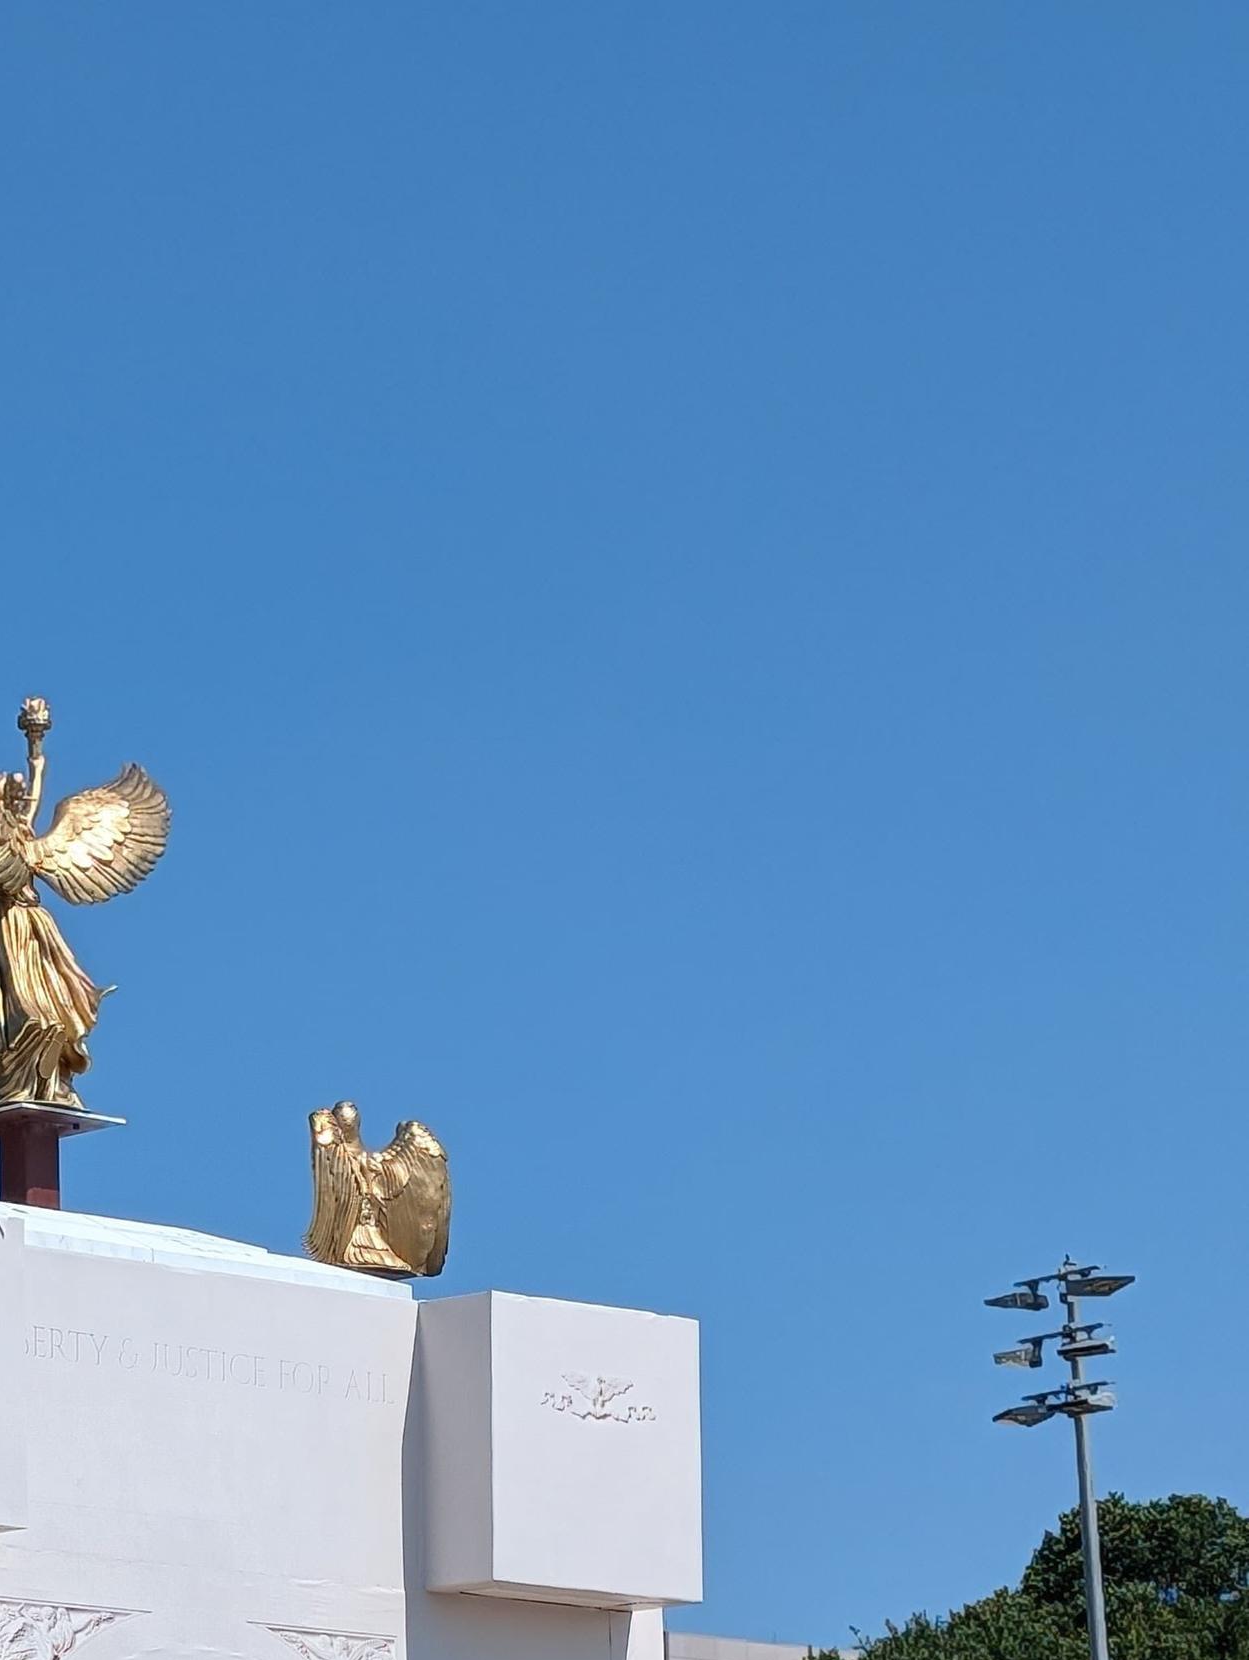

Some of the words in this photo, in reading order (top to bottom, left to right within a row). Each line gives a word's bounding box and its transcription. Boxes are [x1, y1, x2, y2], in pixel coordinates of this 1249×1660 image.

[117, 1336, 139, 1370] &
[152, 1341, 267, 1388] JUSTICE
[279, 1358, 331, 1395] FOR
[344, 1368, 396, 1405] ALL
